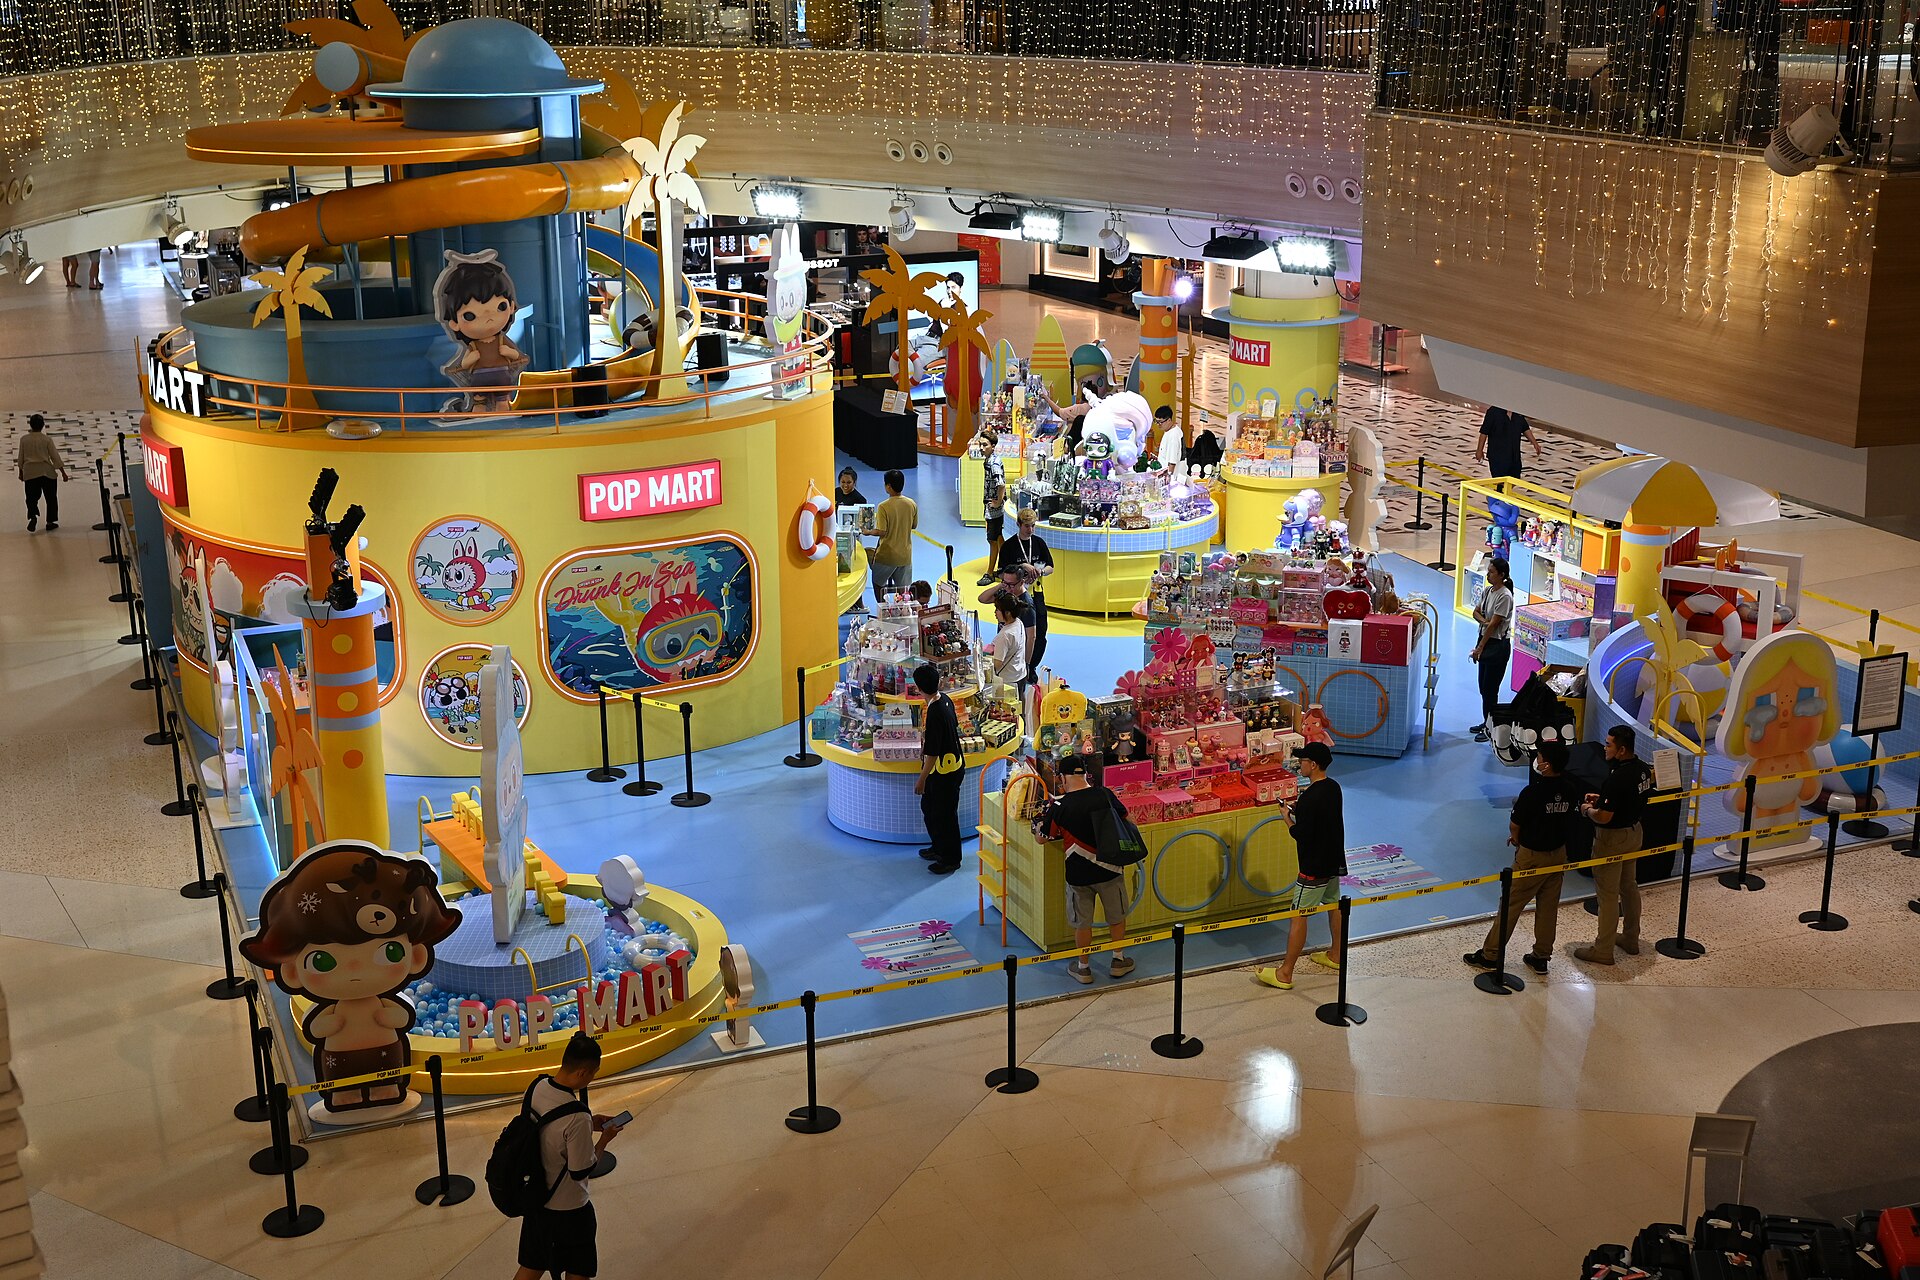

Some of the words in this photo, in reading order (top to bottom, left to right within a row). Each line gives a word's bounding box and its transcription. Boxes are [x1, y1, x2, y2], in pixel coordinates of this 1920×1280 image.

[1236, 341, 1267, 362] MART
[147, 353, 204, 418] MART
[589, 479, 640, 514] POP
[649, 468, 715, 508] MART
[554, 572, 622, 612] Drunk
[623, 572, 654, 596] In
[654, 560, 696, 588] Sea
[460, 995, 554, 1053] POP
[577, 950, 691, 1035] MART
